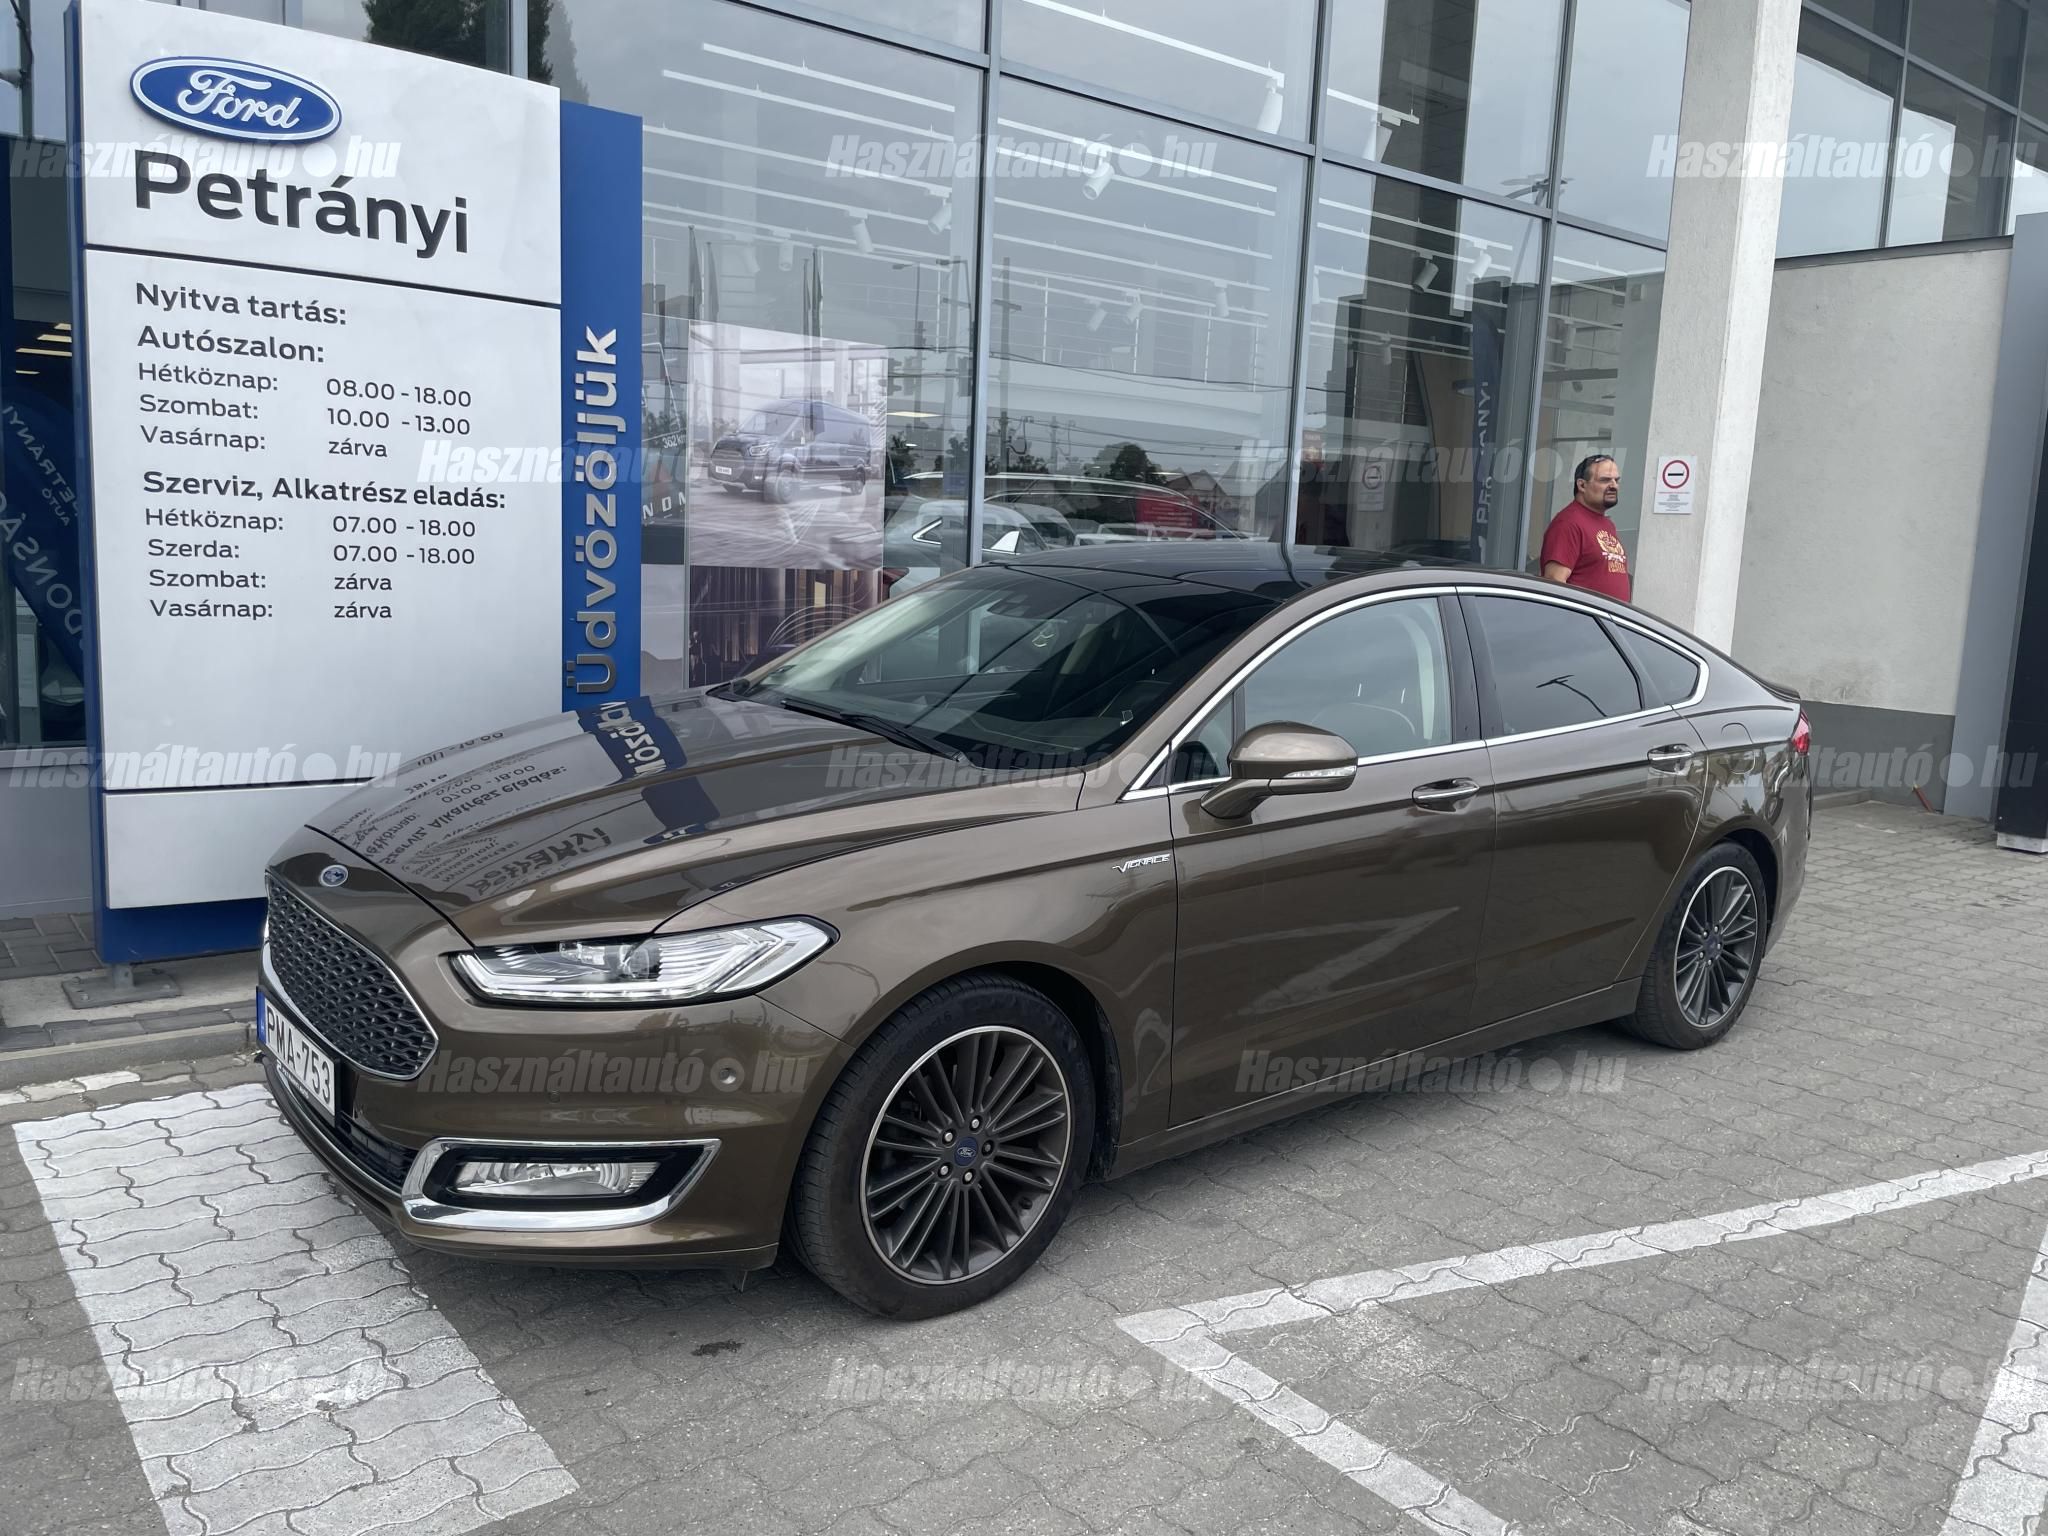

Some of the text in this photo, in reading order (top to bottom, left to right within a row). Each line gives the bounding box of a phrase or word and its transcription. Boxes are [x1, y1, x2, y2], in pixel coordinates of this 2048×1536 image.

[177, 69, 302, 128] Ford
[134, 149, 468, 259] Petrányi
[136, 282, 347, 325] Nyitva tartás:
[137, 325, 325, 363] Autószalon:
[138, 363, 278, 392] Hétköznap:
[140, 394, 259, 419] Szombat:
[326, 378, 395, 400] 08.00
[414, 386, 472, 408] 18.00
[327, 408, 390, 429] 10.00
[415, 415, 471, 435] 13.00
[140, 425, 265, 452] Vasárnap:
[328, 439, 388, 458] zárva
[143, 471, 505, 509] Szerviz, Alkatrész eladás:
[145, 508, 284, 533] Hétköznap:
[566, 325, 626, 693] Üdvözöljük
[333, 516, 397, 534] 07.00
[419, 519, 475, 537] 18.00
[148, 538, 239, 559] Szerda:
[333, 545, 397, 563] 07.00
[419, 547, 475, 565] 18.00
[149, 569, 266, 589] Szombat:
[334, 573, 392, 591] zárva
[150, 599, 273, 620] Vasárnap:
[334, 602, 392, 619] zárva
[266, 1005, 331, 1105] PMA-753
